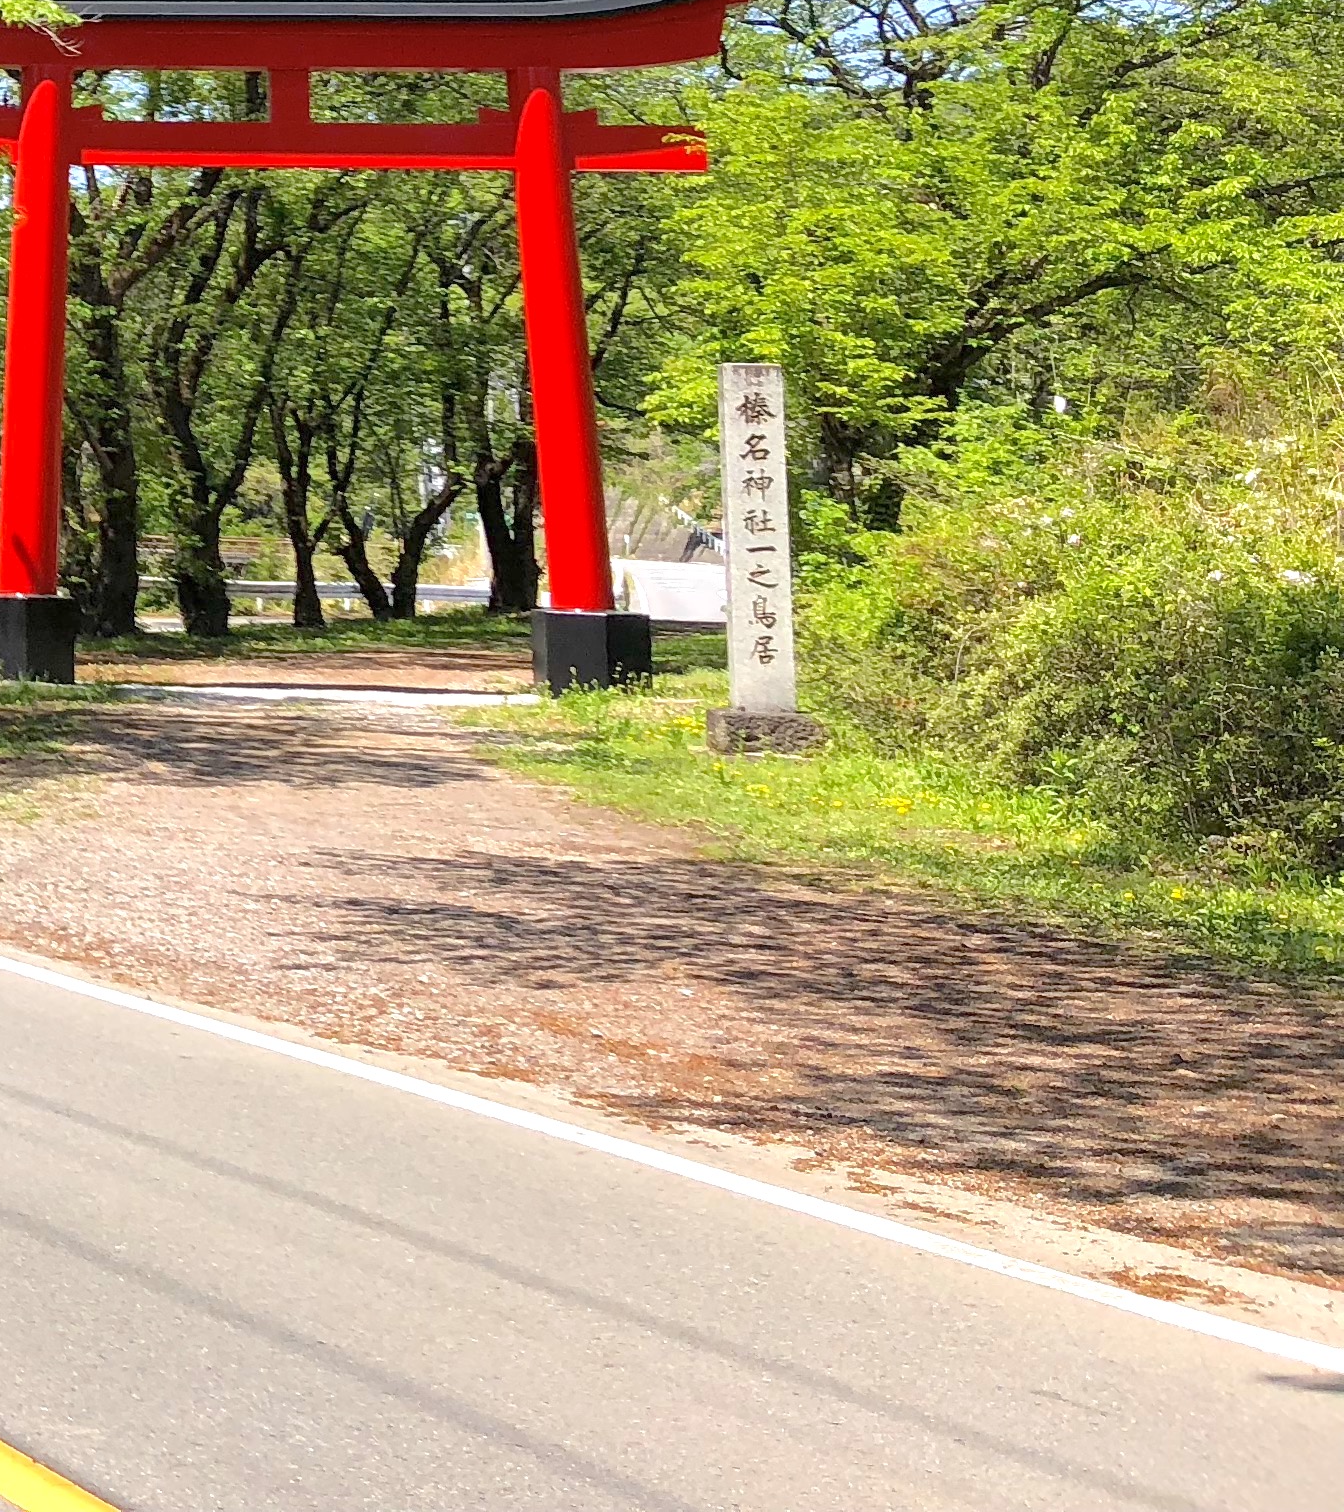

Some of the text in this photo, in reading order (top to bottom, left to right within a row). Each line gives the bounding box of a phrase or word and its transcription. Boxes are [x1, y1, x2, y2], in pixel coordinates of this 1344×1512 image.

[735, 391, 780, 666] 榛名神社一之鳥居
